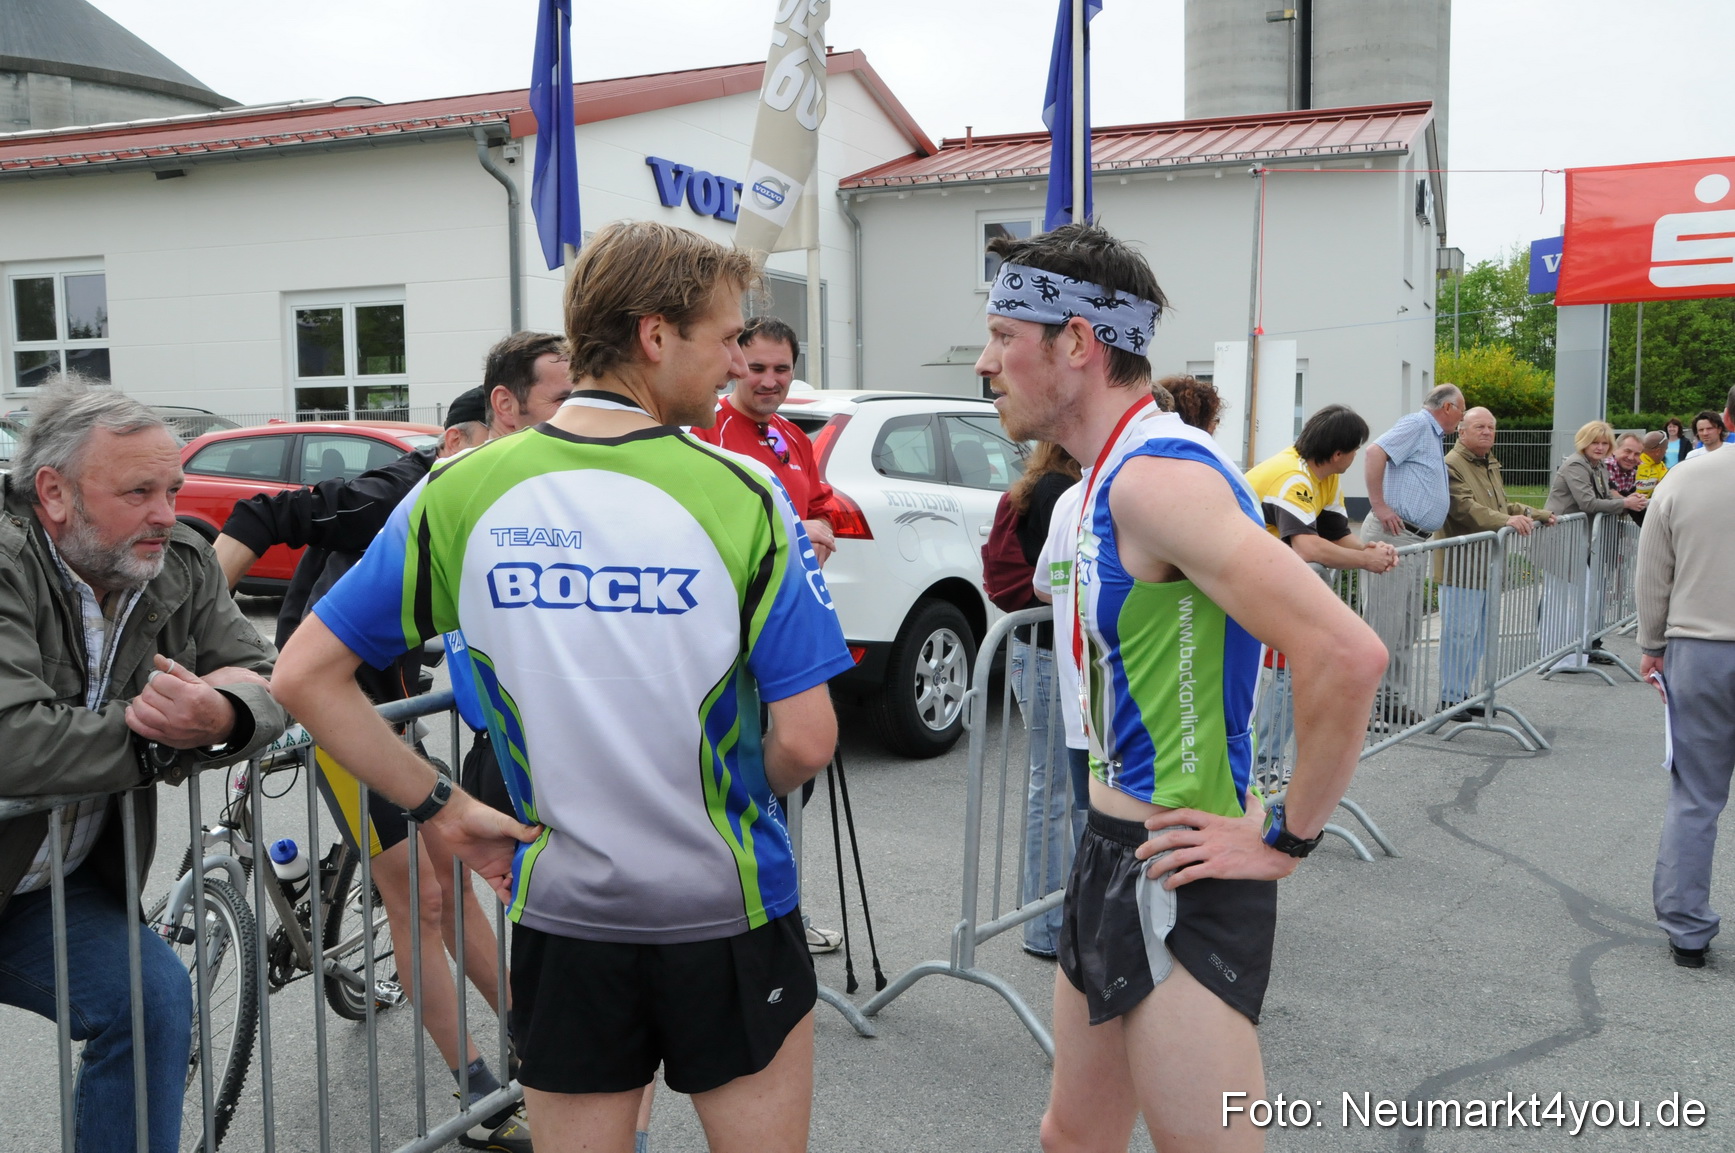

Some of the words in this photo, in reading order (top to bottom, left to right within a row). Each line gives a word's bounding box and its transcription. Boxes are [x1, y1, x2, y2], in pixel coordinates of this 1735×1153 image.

[645, 156, 743, 224] VOL
[755, 184, 782, 202] VOLVO
[912, 491, 959, 513] TESTEN!
[491, 527, 582, 549] TEAM
[486, 562, 701, 615] BOCK
[1178, 594, 1199, 774] www.bockonline.de
